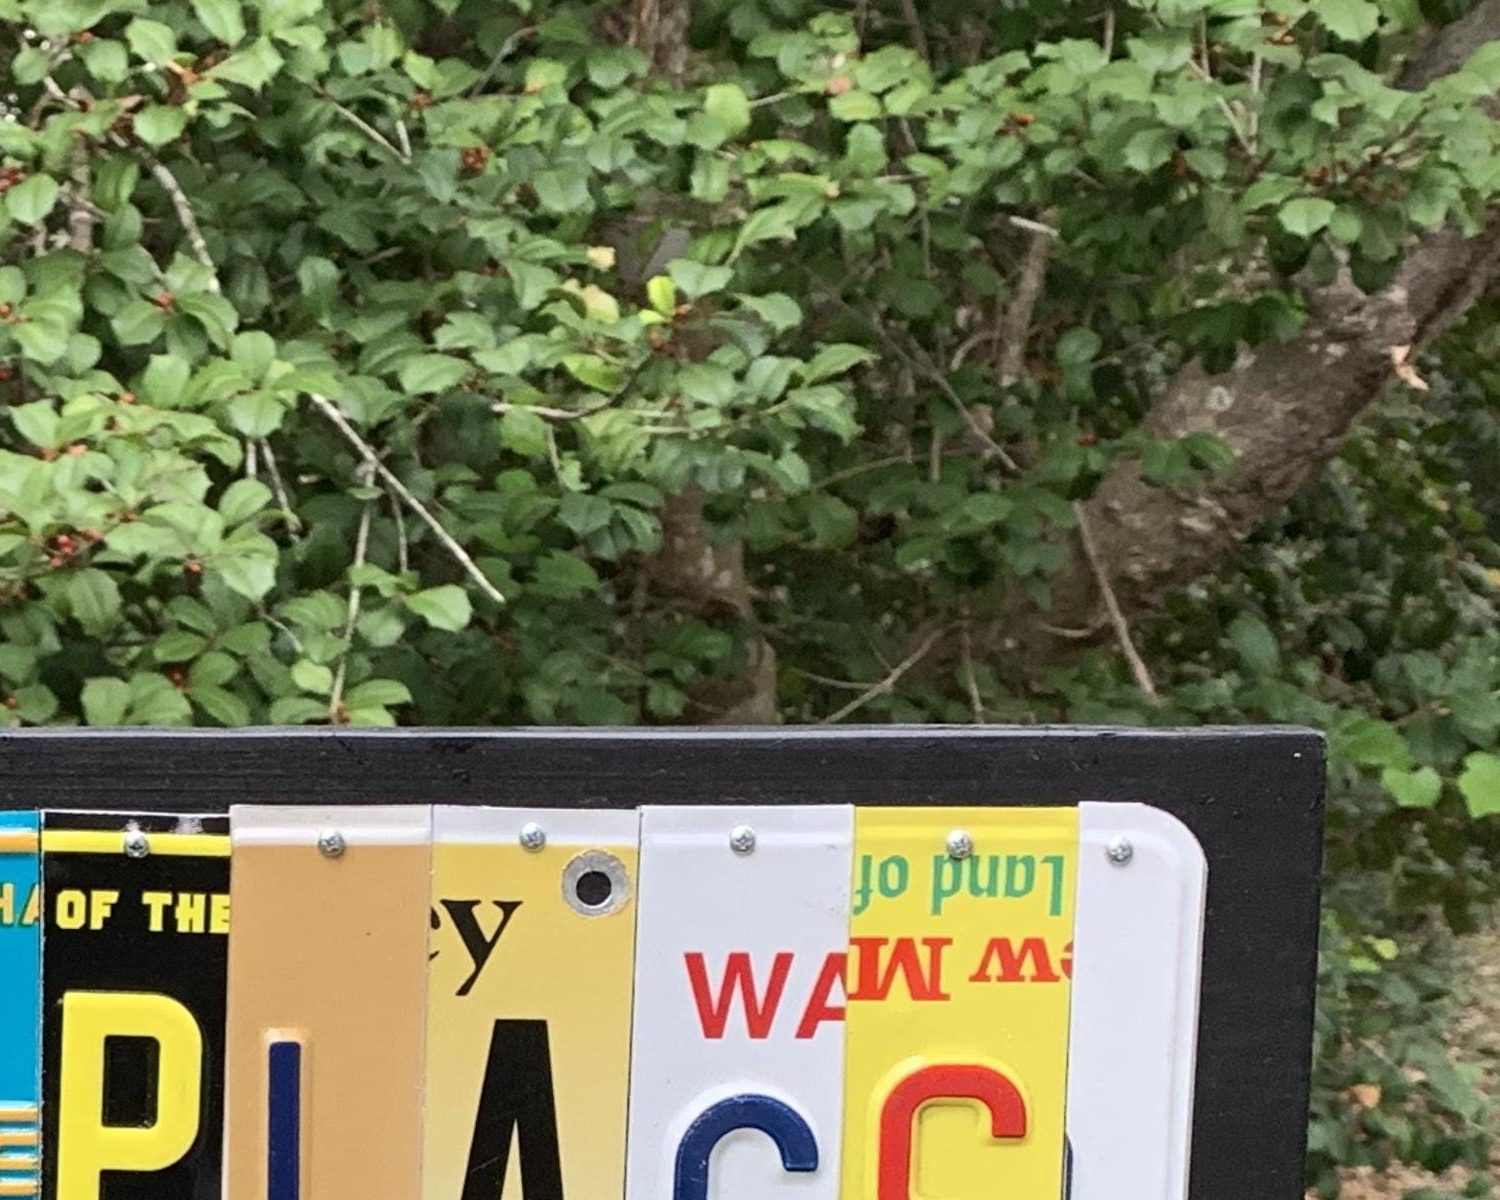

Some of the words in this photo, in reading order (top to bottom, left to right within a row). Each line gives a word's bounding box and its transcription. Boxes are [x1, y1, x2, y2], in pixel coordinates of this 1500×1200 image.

[56, 889, 120, 930] OF
[142, 891, 231, 934] THE
[852, 854, 910, 917] of
[931, 854, 1065, 917] Land
[429, 899, 524, 997] y
